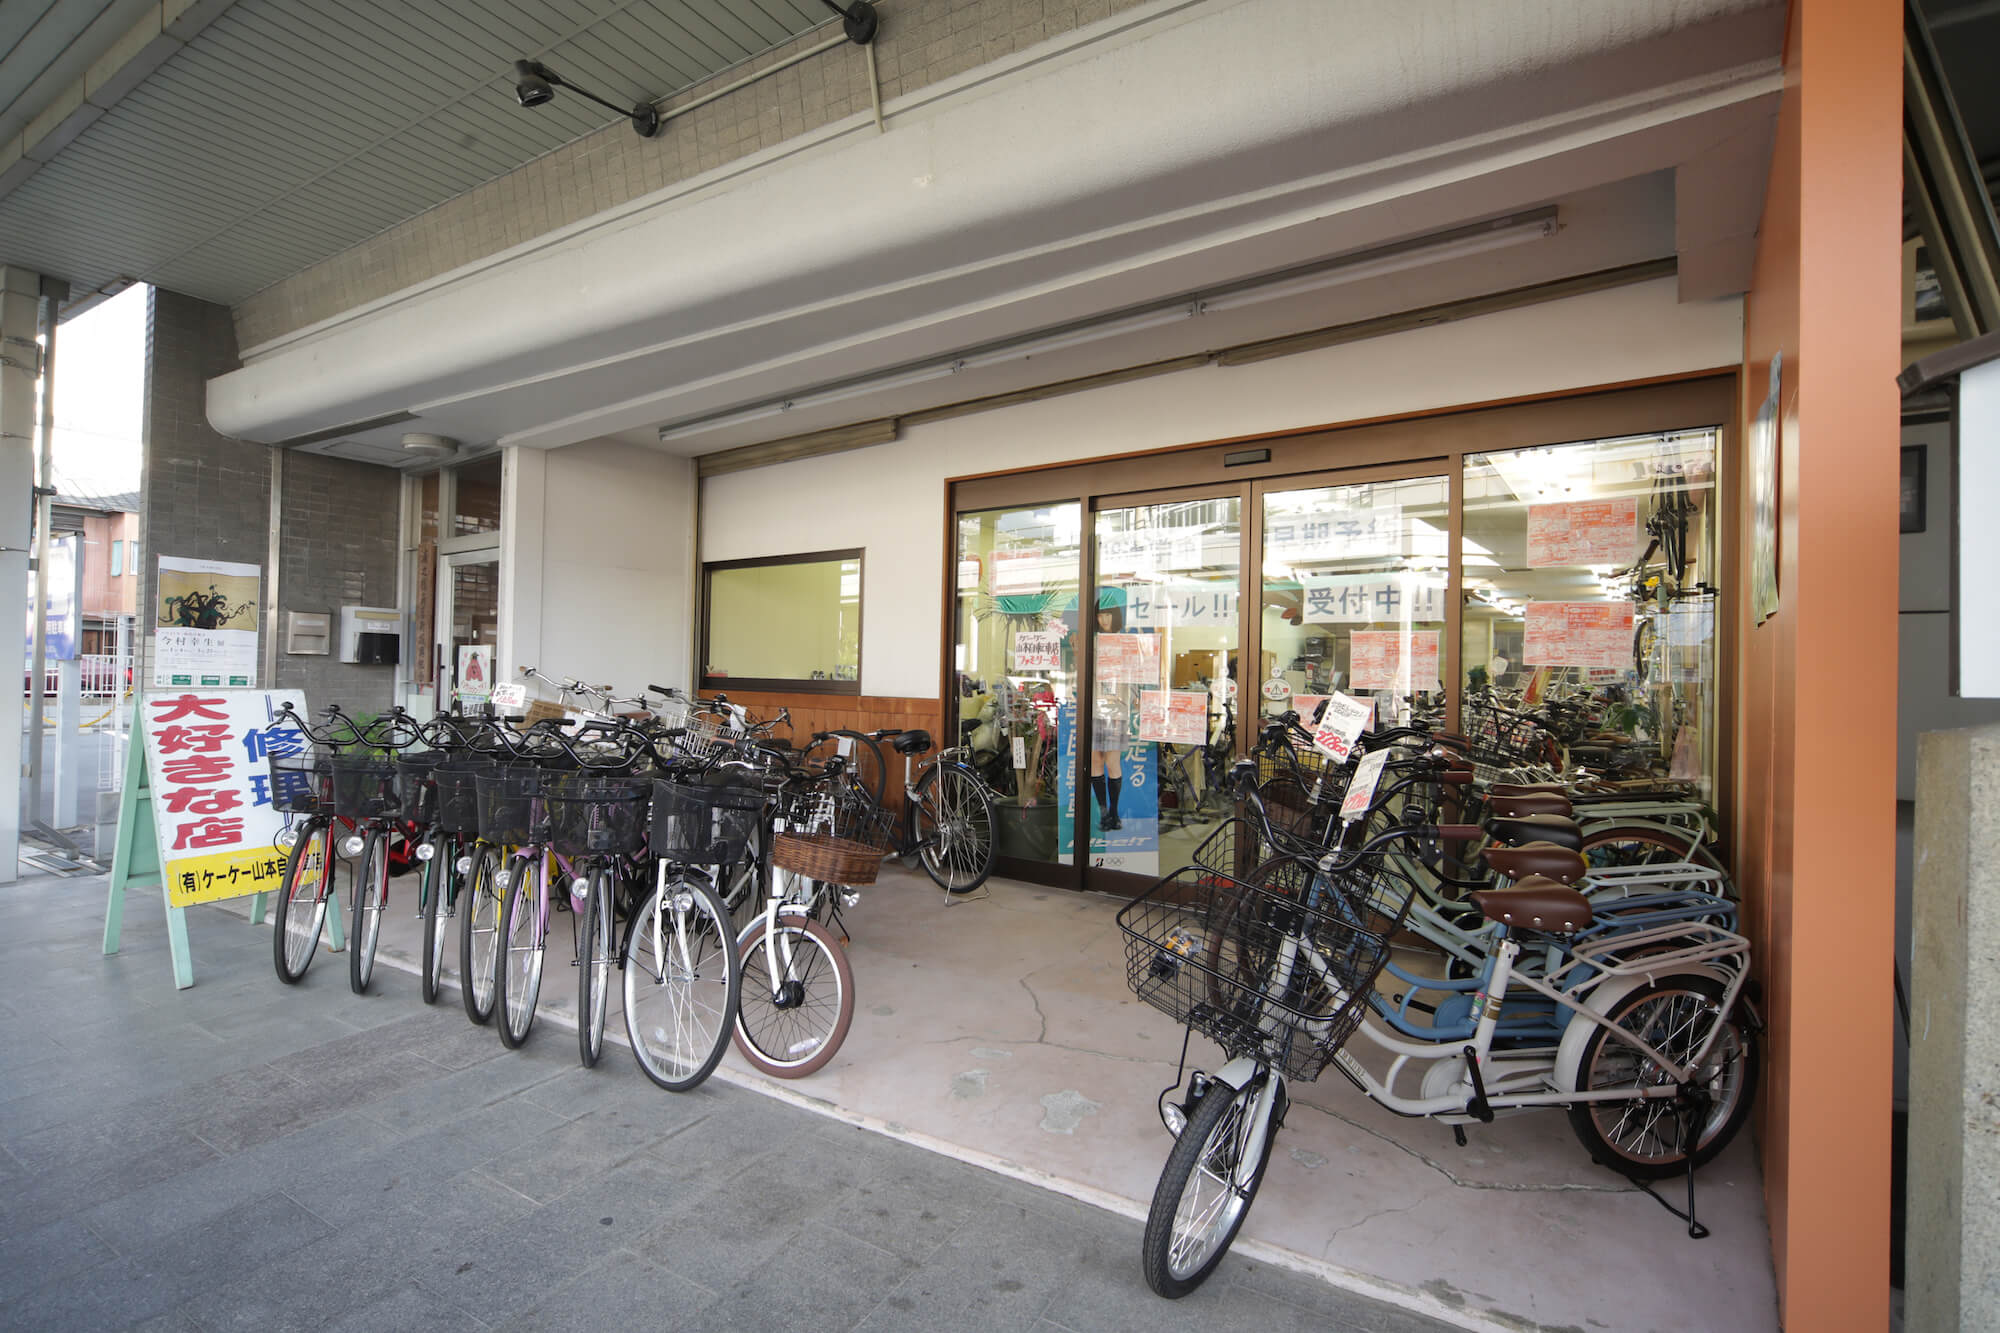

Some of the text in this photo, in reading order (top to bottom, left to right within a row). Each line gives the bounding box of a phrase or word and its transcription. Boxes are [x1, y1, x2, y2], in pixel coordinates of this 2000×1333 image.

[150, 694, 244, 850] 大好きな店
[242, 727, 310, 808] 修理
[179, 852, 321, 894] (有)ケーケー山本自
